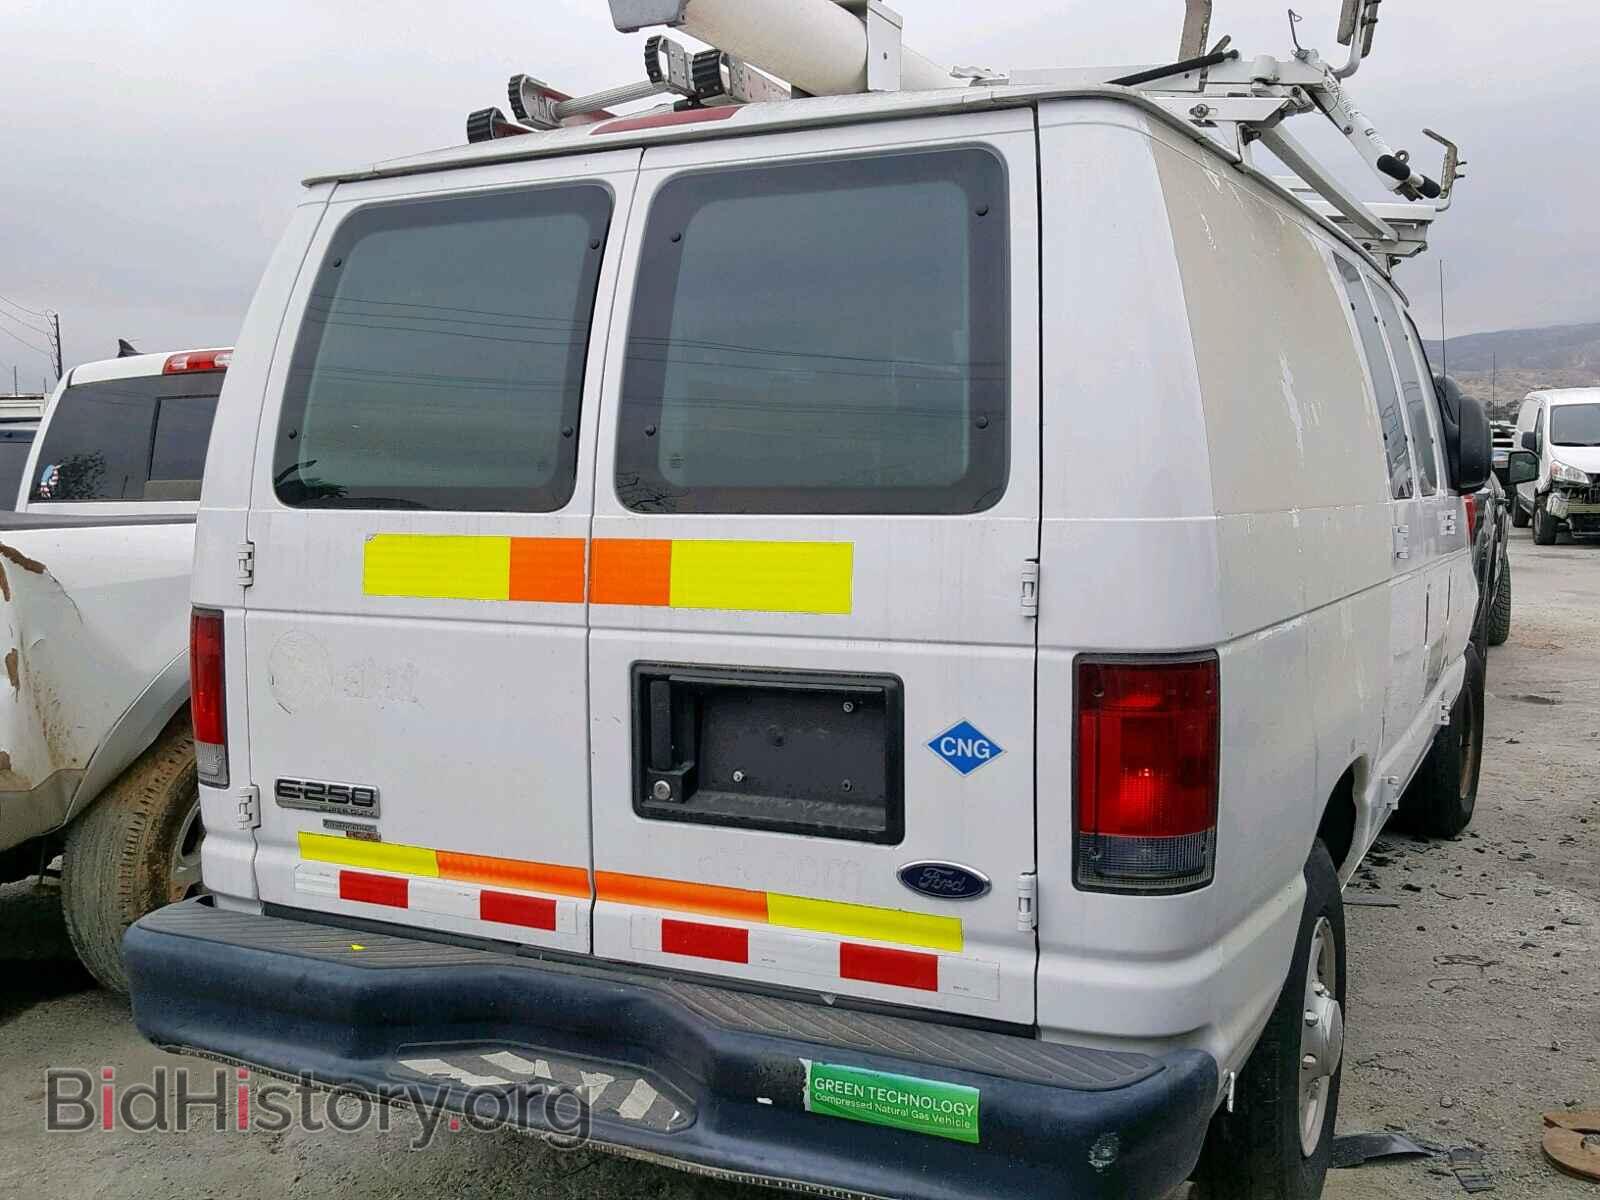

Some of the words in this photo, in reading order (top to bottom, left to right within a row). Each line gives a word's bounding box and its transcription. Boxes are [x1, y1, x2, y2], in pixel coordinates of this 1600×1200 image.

[940, 736, 991, 759] CNG
[918, 867, 967, 893] Ford
[814, 1077, 865, 1098] GREEN
[866, 1086, 976, 1118] TECHNOLOGY
[814, 1092, 873, 1111] Compressed
[874, 1103, 909, 1117] Natural
[911, 1110, 930, 1121] Gas
[932, 1114, 971, 1129] Vehicle
